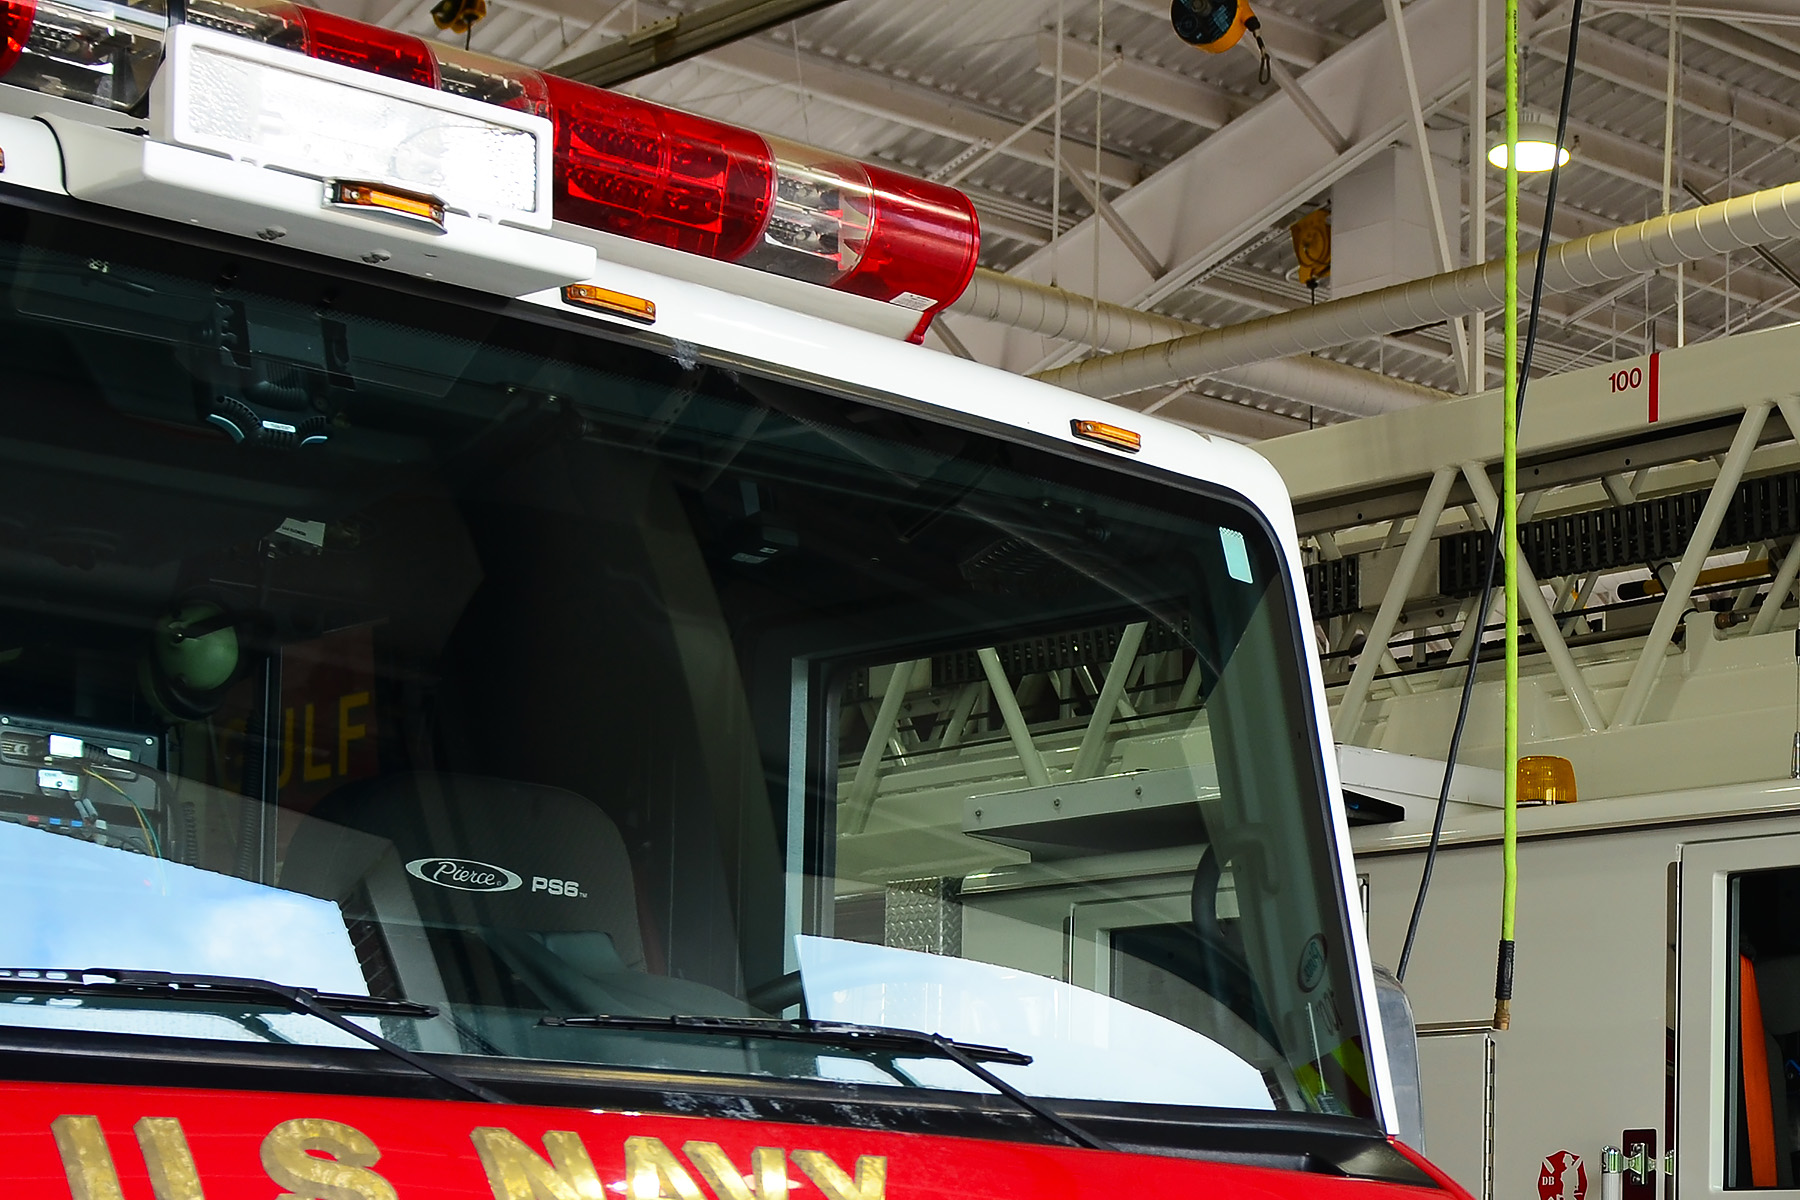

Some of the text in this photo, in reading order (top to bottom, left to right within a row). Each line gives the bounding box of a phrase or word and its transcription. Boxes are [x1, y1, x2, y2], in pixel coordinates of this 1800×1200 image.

[1608, 367, 1643, 393] 100
[432, 861, 496, 887] Pierce
[1542, 1176, 1555, 1186] DB
